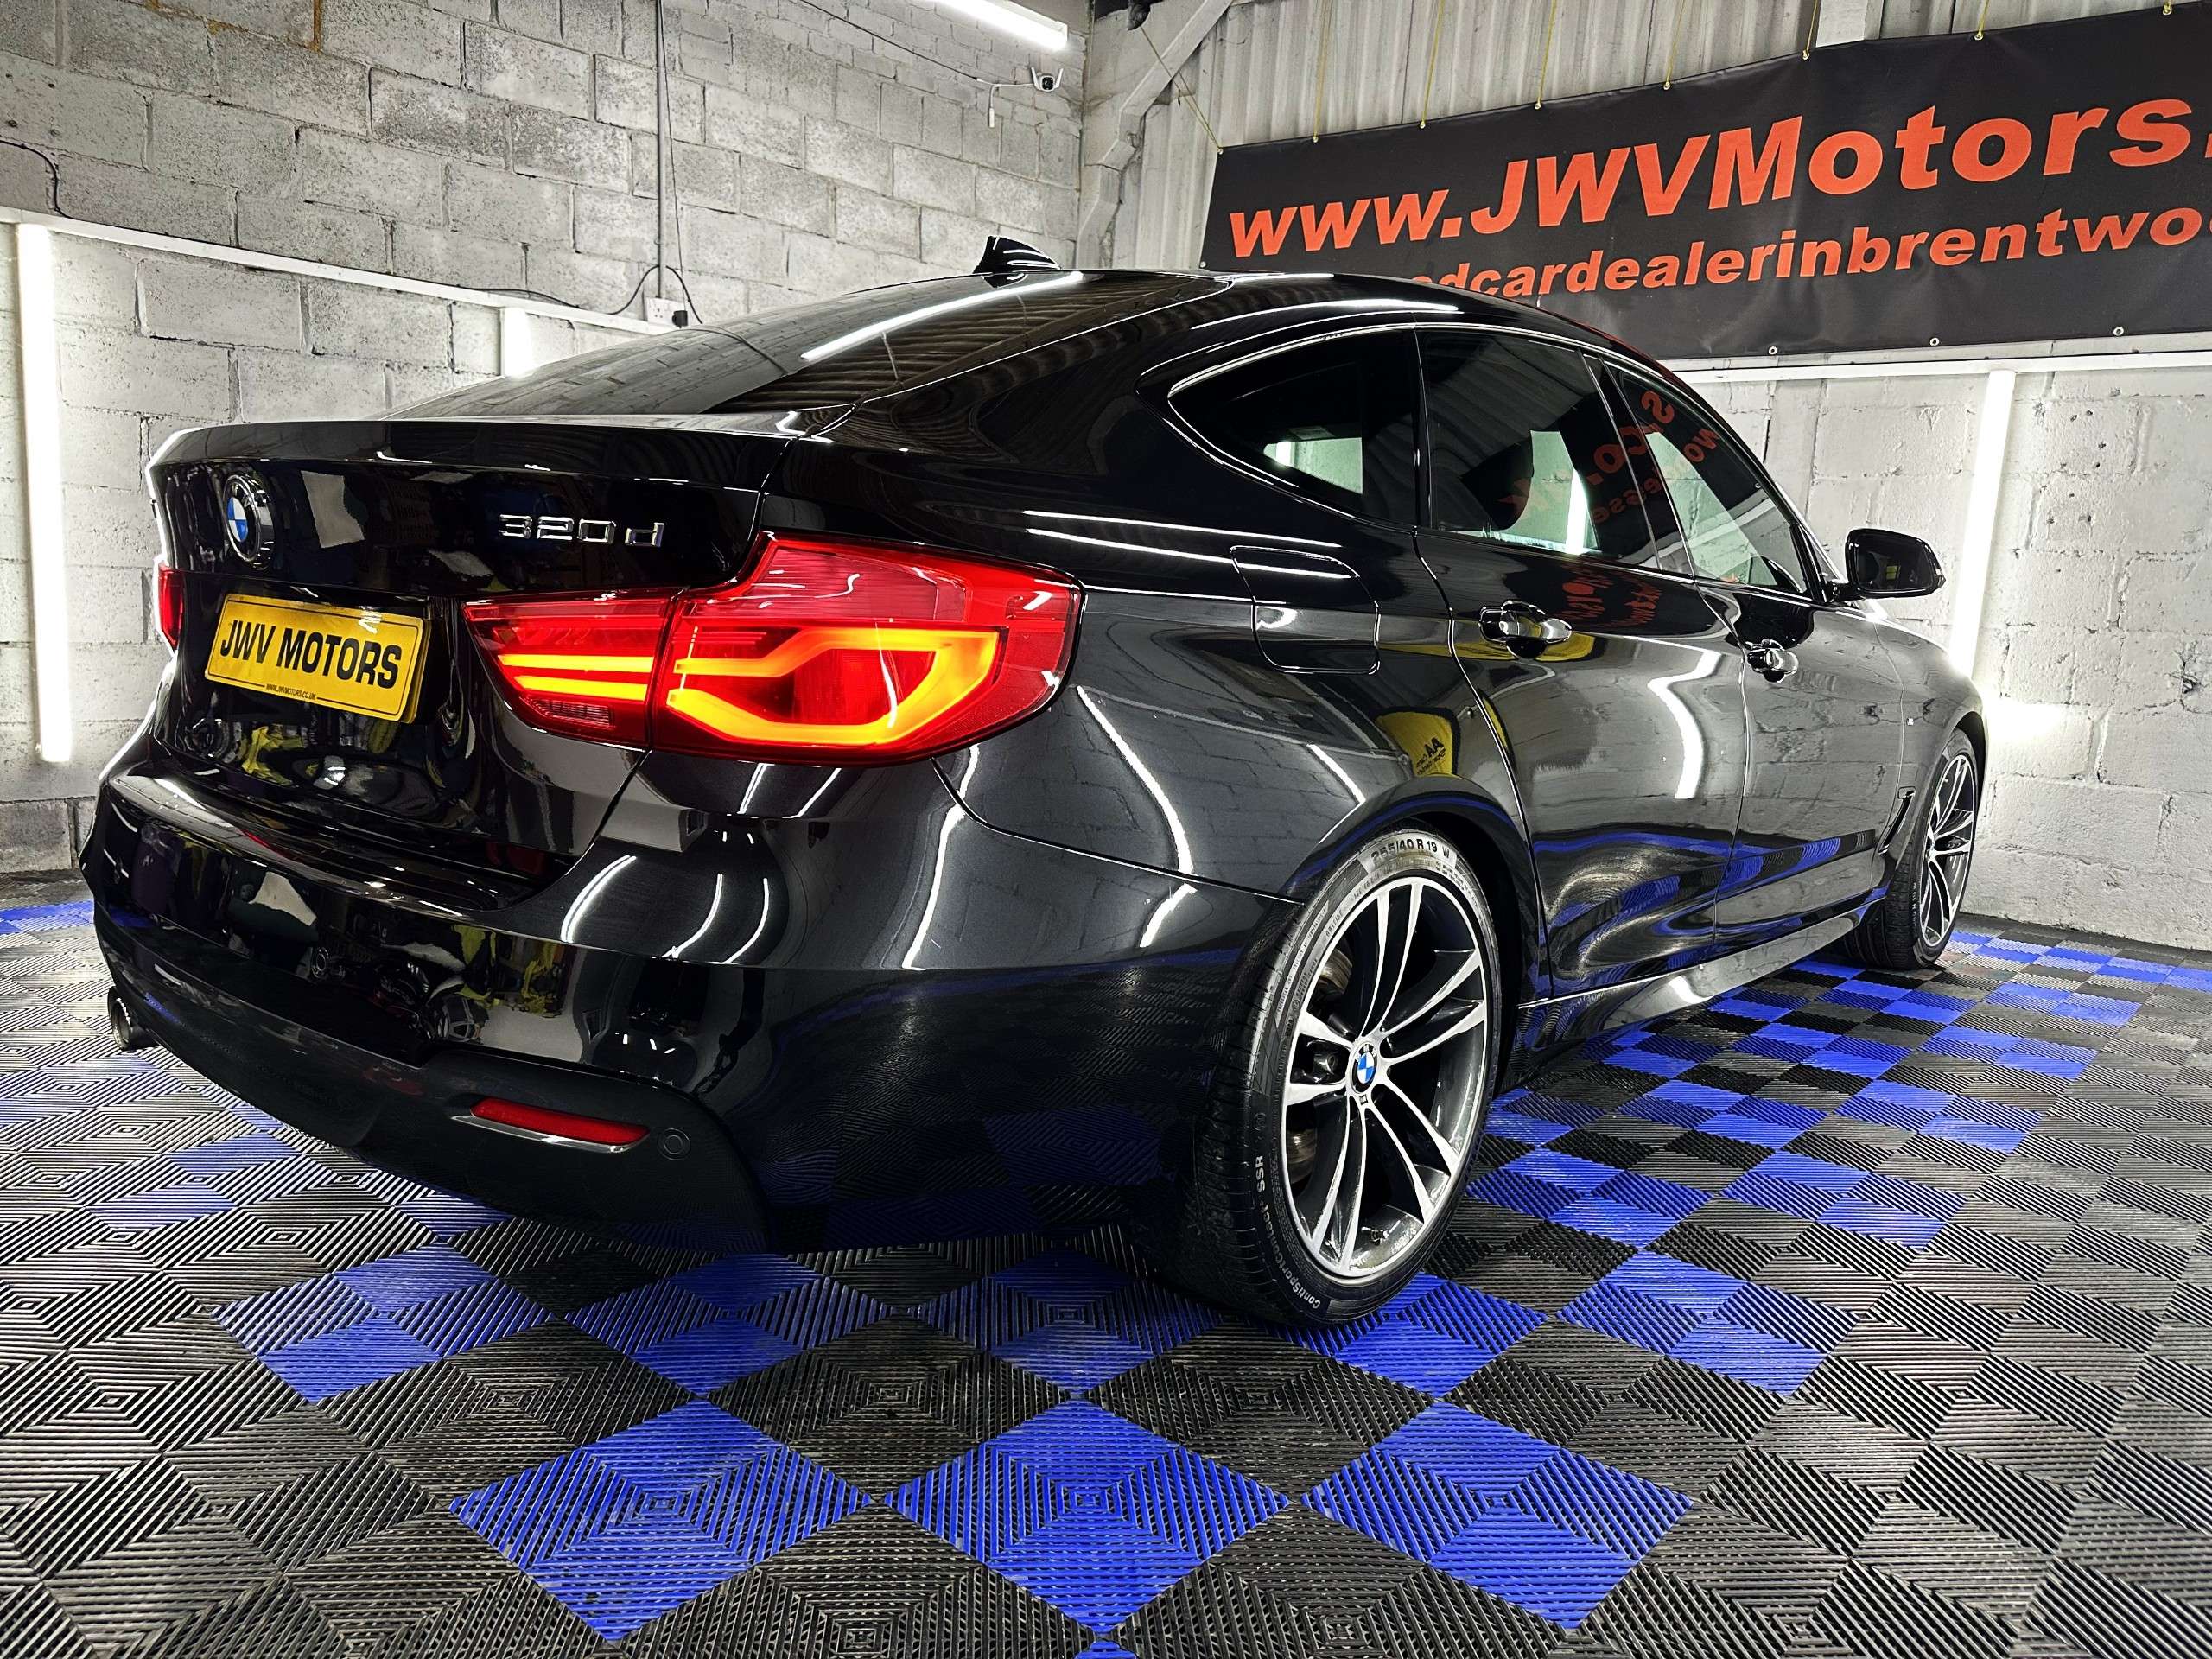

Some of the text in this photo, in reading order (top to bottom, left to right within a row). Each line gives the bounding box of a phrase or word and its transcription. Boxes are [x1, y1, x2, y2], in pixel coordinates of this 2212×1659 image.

[1411, 207, 2212, 298] dcardealerinbrentwo
[219, 619, 403, 690] JWV MOTORS
[1416, 838, 1425, 850] R
[1426, 840, 1438, 853] 19
[1255, 1155, 1266, 1192] SSR
